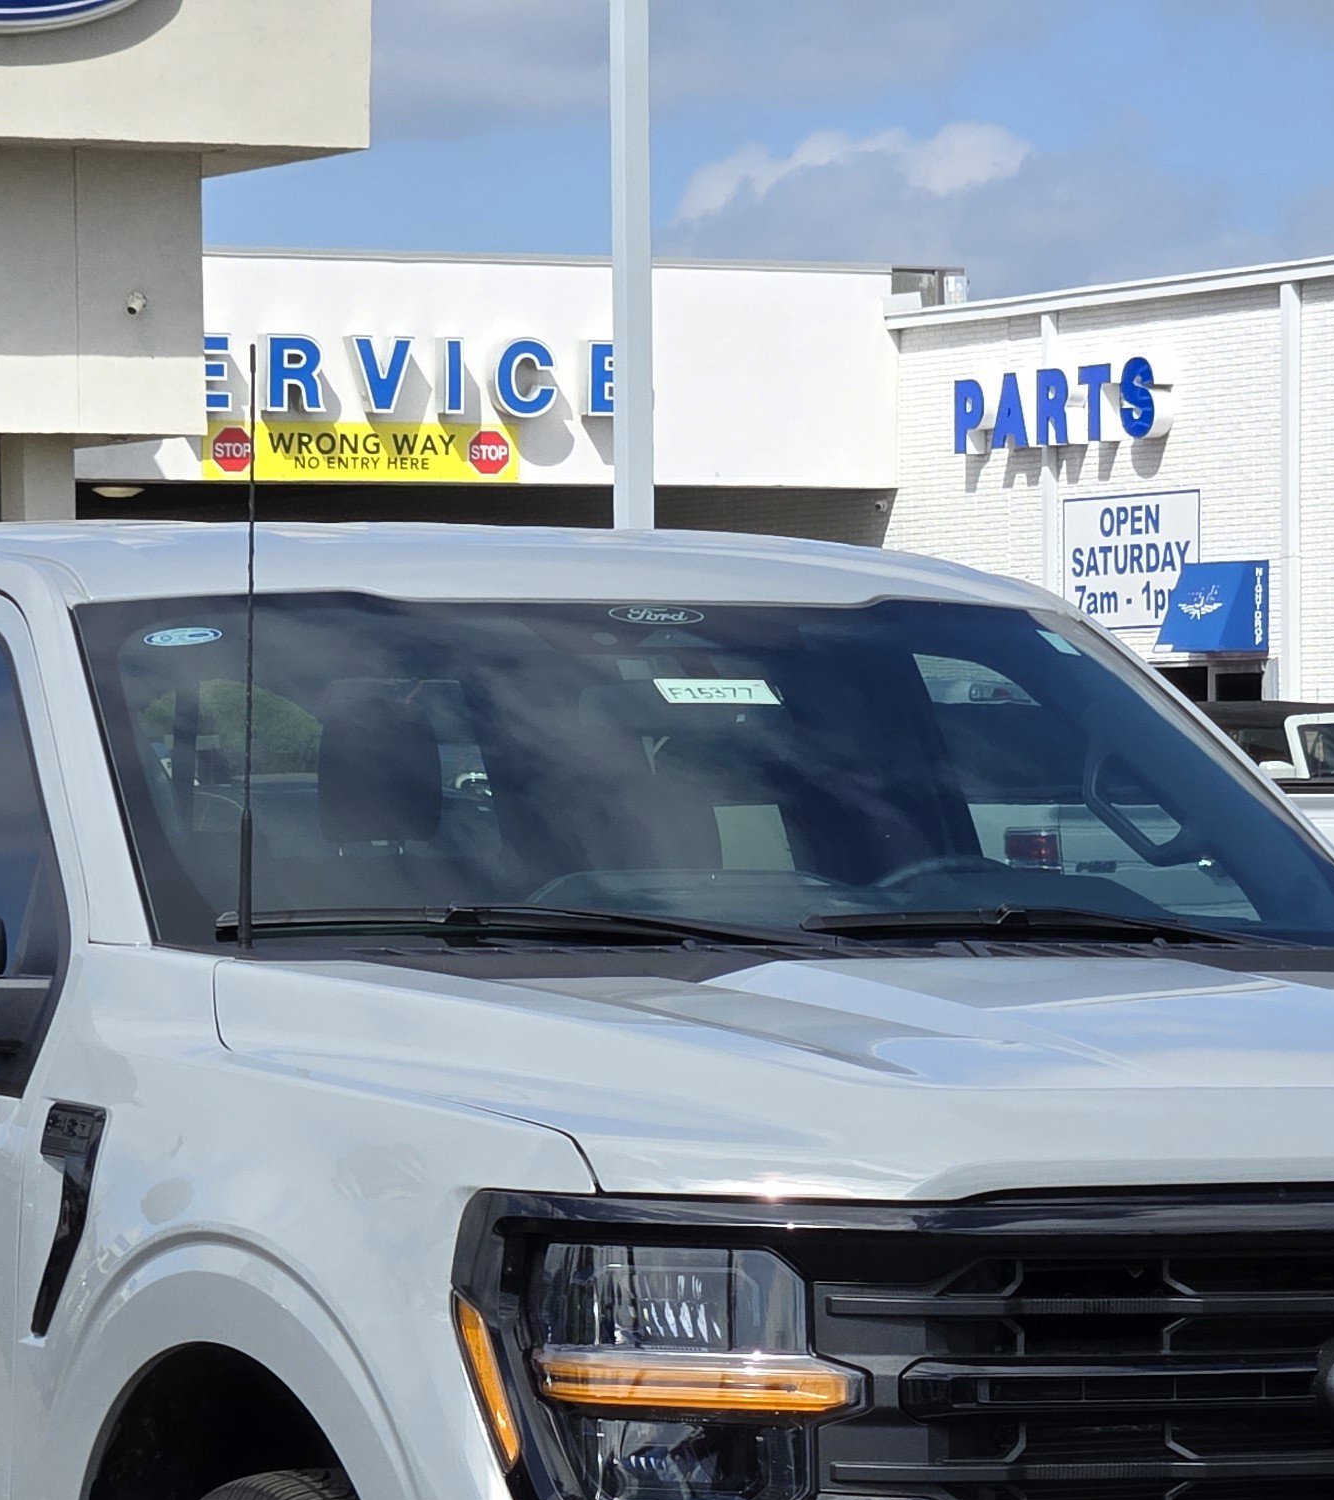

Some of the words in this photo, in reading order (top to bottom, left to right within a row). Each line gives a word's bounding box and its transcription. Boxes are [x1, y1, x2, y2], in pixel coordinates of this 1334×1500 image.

[954, 357, 1155, 454] PARTS
[214, 441, 251, 460] STOP
[268, 433, 381, 456] WRONG
[392, 433, 456, 456] WAY
[471, 444, 508, 461] STOP
[294, 456, 320, 469] NO
[327, 457, 380, 470] ENTRY
[387, 457, 430, 470] HERE
[1100, 504, 1160, 537] OPEN
[1071, 540, 1191, 577] SATURDAY
[1075, 585, 1118, 616] 7am
[1141, 581, 1174, 618] 1p
[627, 608, 688, 621] Ford
[668, 686, 753, 700] F15377
